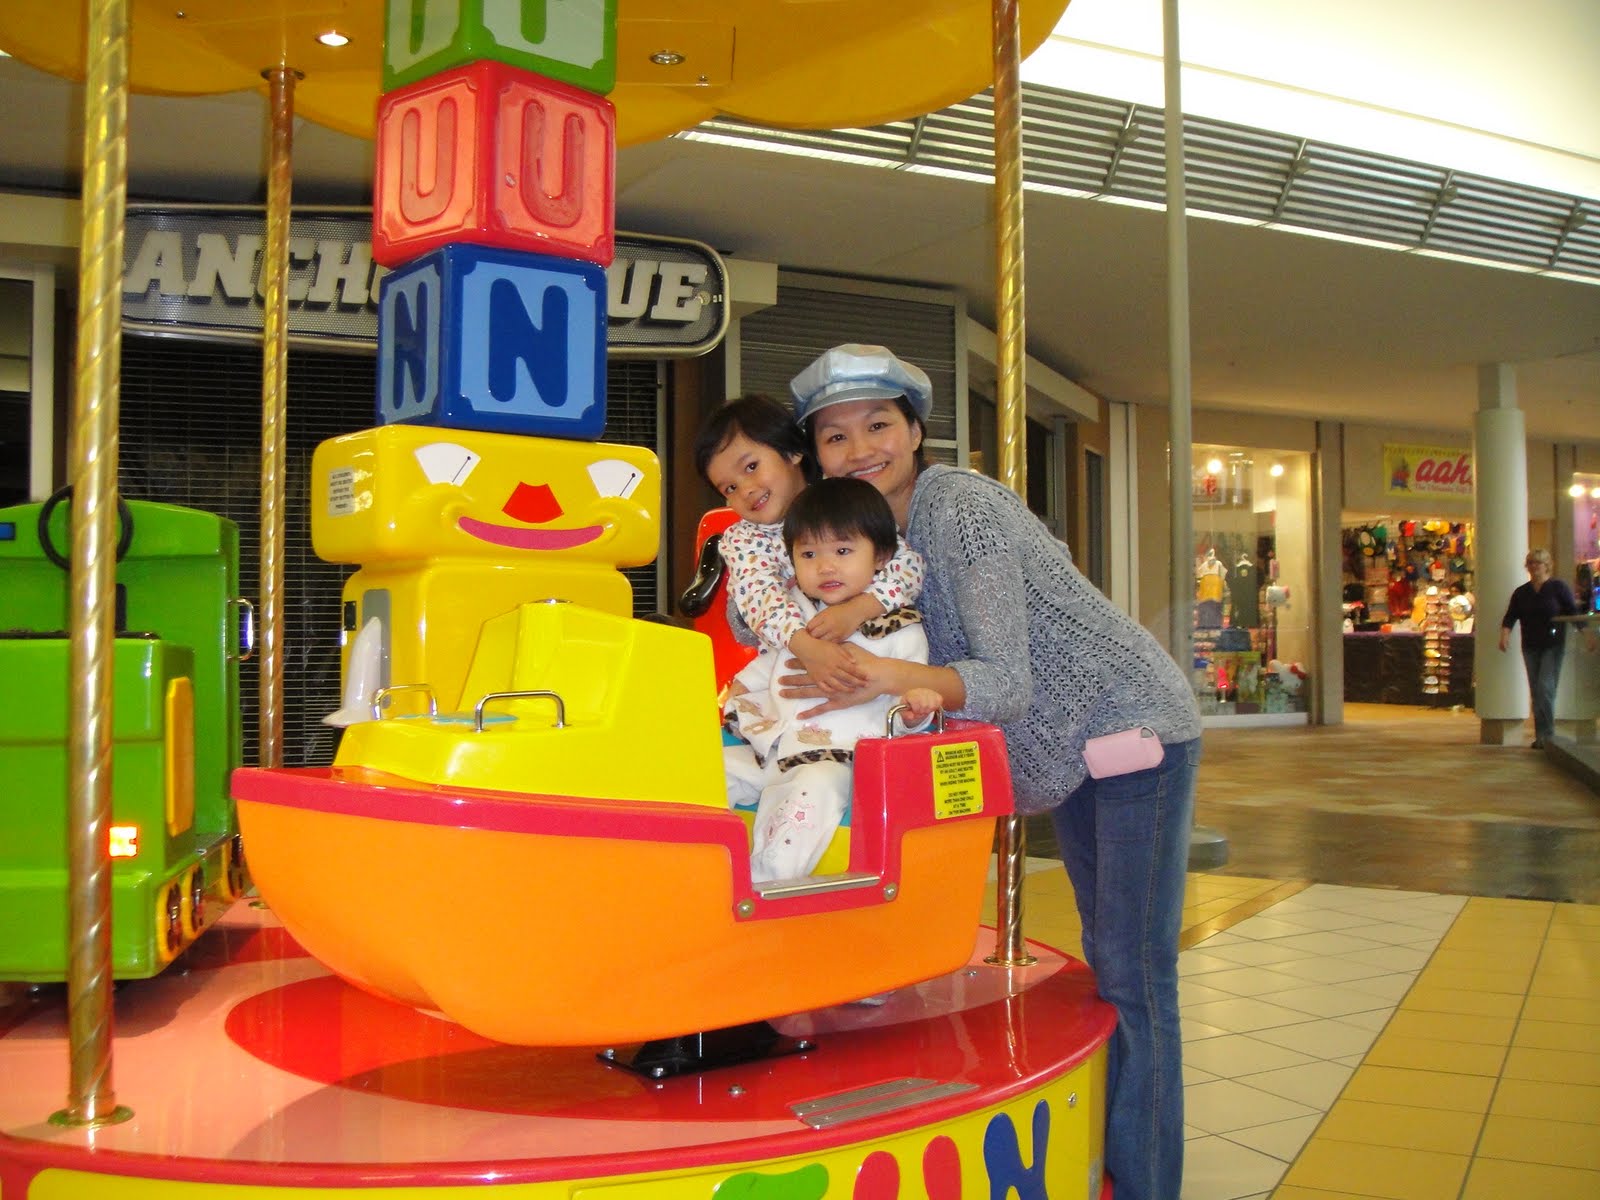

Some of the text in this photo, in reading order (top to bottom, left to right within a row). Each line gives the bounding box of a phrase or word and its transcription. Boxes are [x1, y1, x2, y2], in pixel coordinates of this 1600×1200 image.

[400, 96, 458, 226] U
[519, 98, 585, 229] U
[122, 231, 708, 321] ANCH UE
[393, 281, 428, 410] N
[488, 278, 568, 407] N
[1415, 454, 1472, 485] aah
